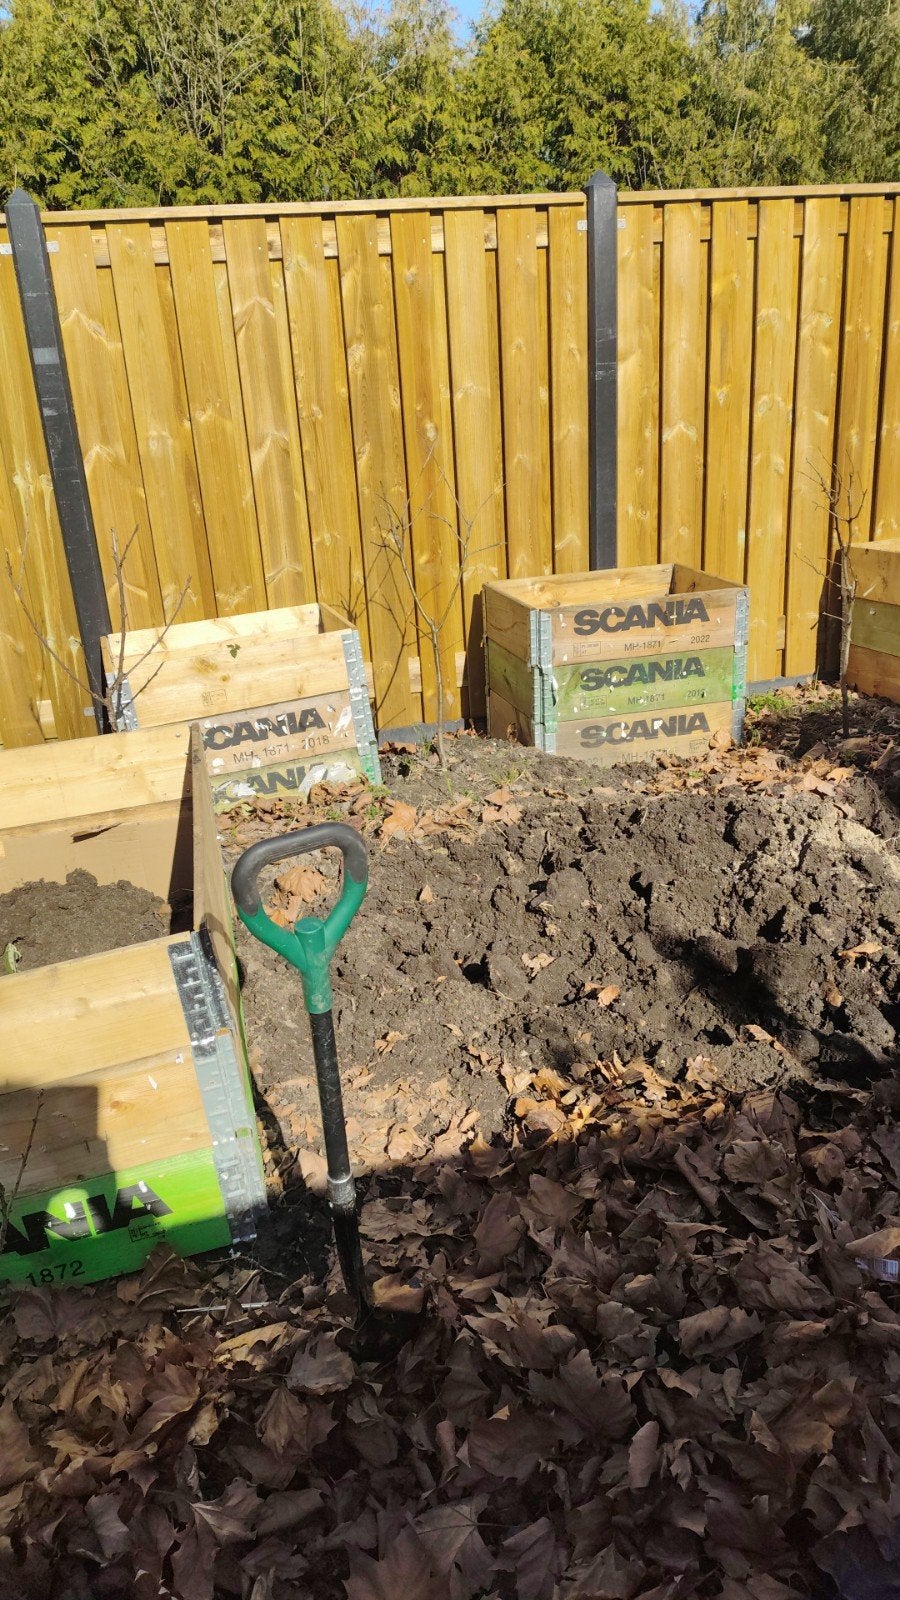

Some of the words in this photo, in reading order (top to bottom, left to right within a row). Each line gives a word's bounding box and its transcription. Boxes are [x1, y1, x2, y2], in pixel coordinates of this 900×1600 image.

[573, 597, 710, 636] SCANIA
[690, 634, 711, 644] 2022
[579, 656, 706, 692] SCANIA
[202, 707, 327, 751] CANIA
[301, 735, 330, 750] 2018
[579, 711, 711, 749] SCANIA
[25, 1260, 86, 1288] 1872
